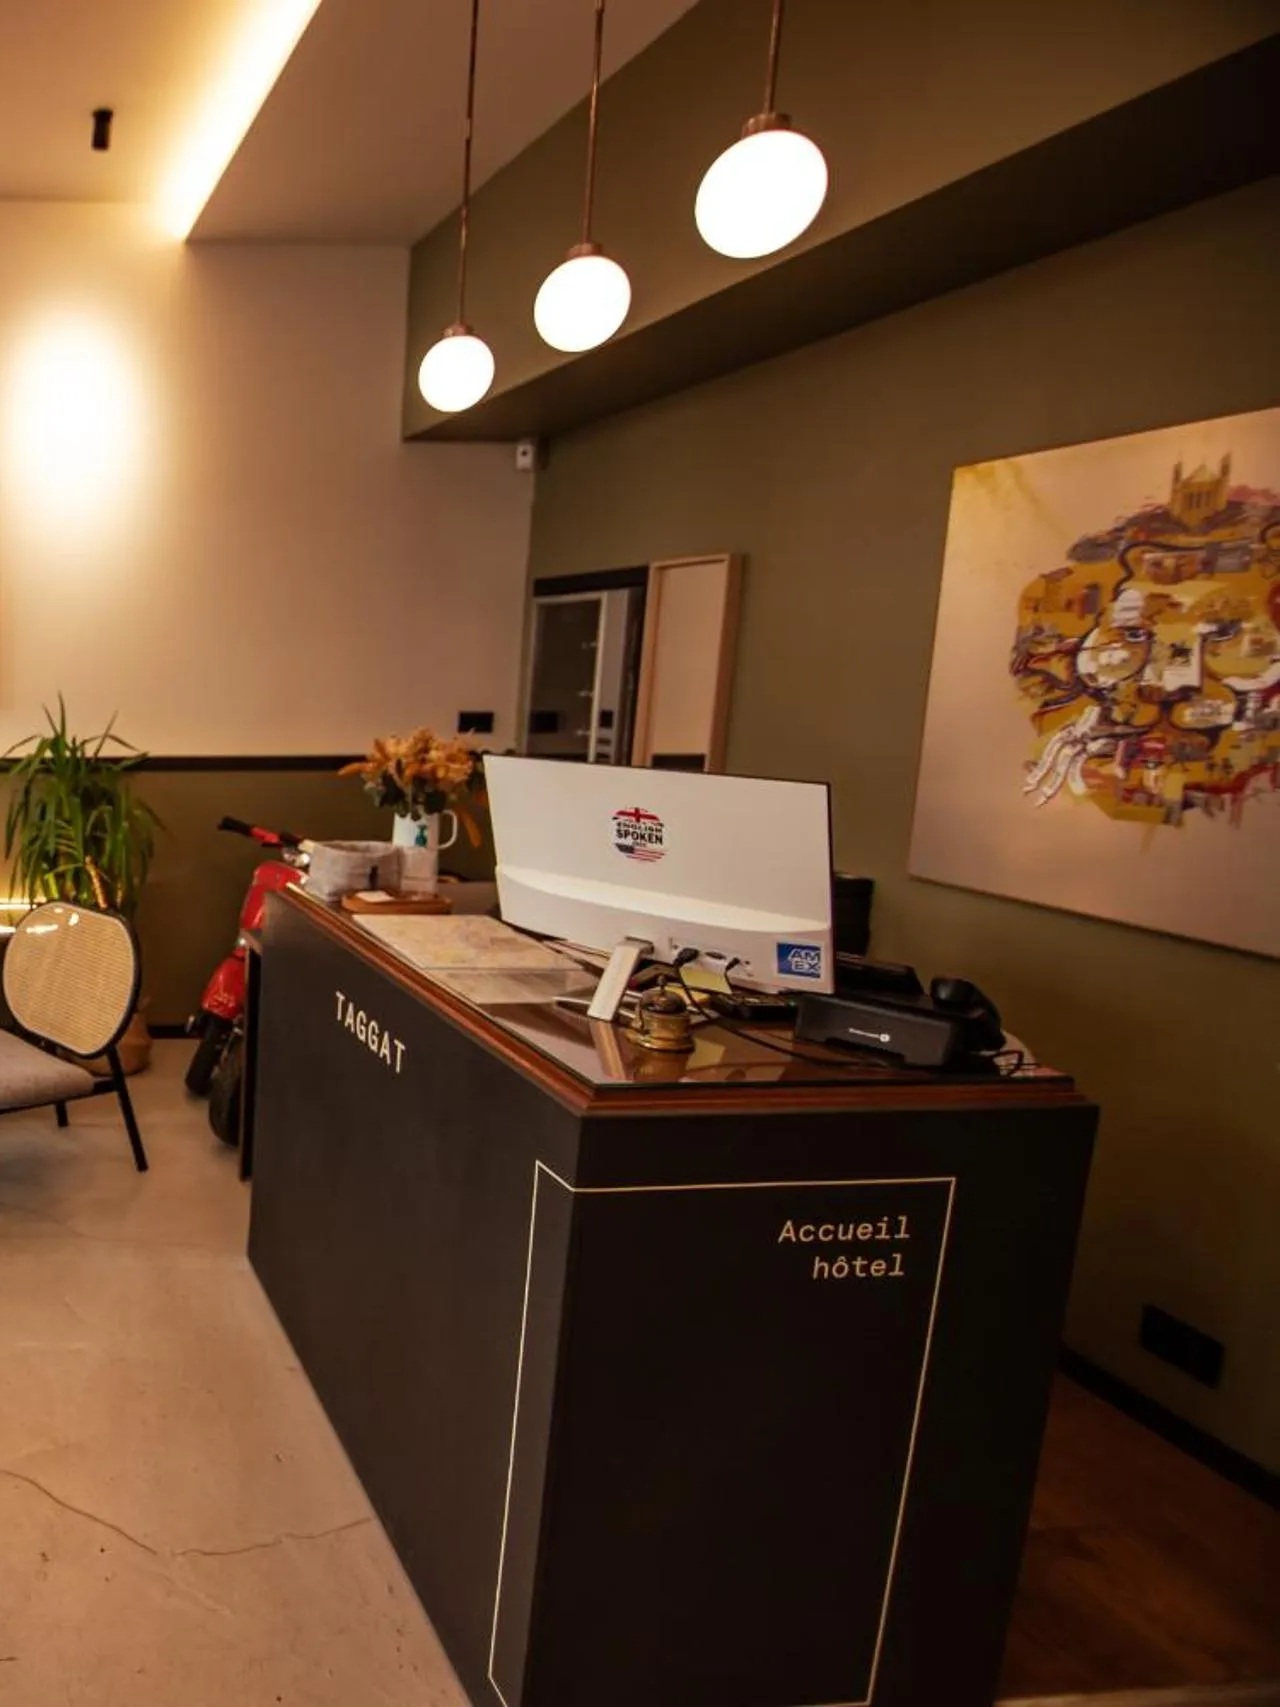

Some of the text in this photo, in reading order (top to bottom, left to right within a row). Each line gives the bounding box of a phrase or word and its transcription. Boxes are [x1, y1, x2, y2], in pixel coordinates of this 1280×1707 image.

[616, 828, 663, 846] SPOKEN
[787, 948, 821, 962] AM
[791, 959, 821, 973] EX
[335, 990, 406, 1074] TAGGAT
[778, 1215, 911, 1244] Accueil
[812, 1253, 905, 1280] hôtel
